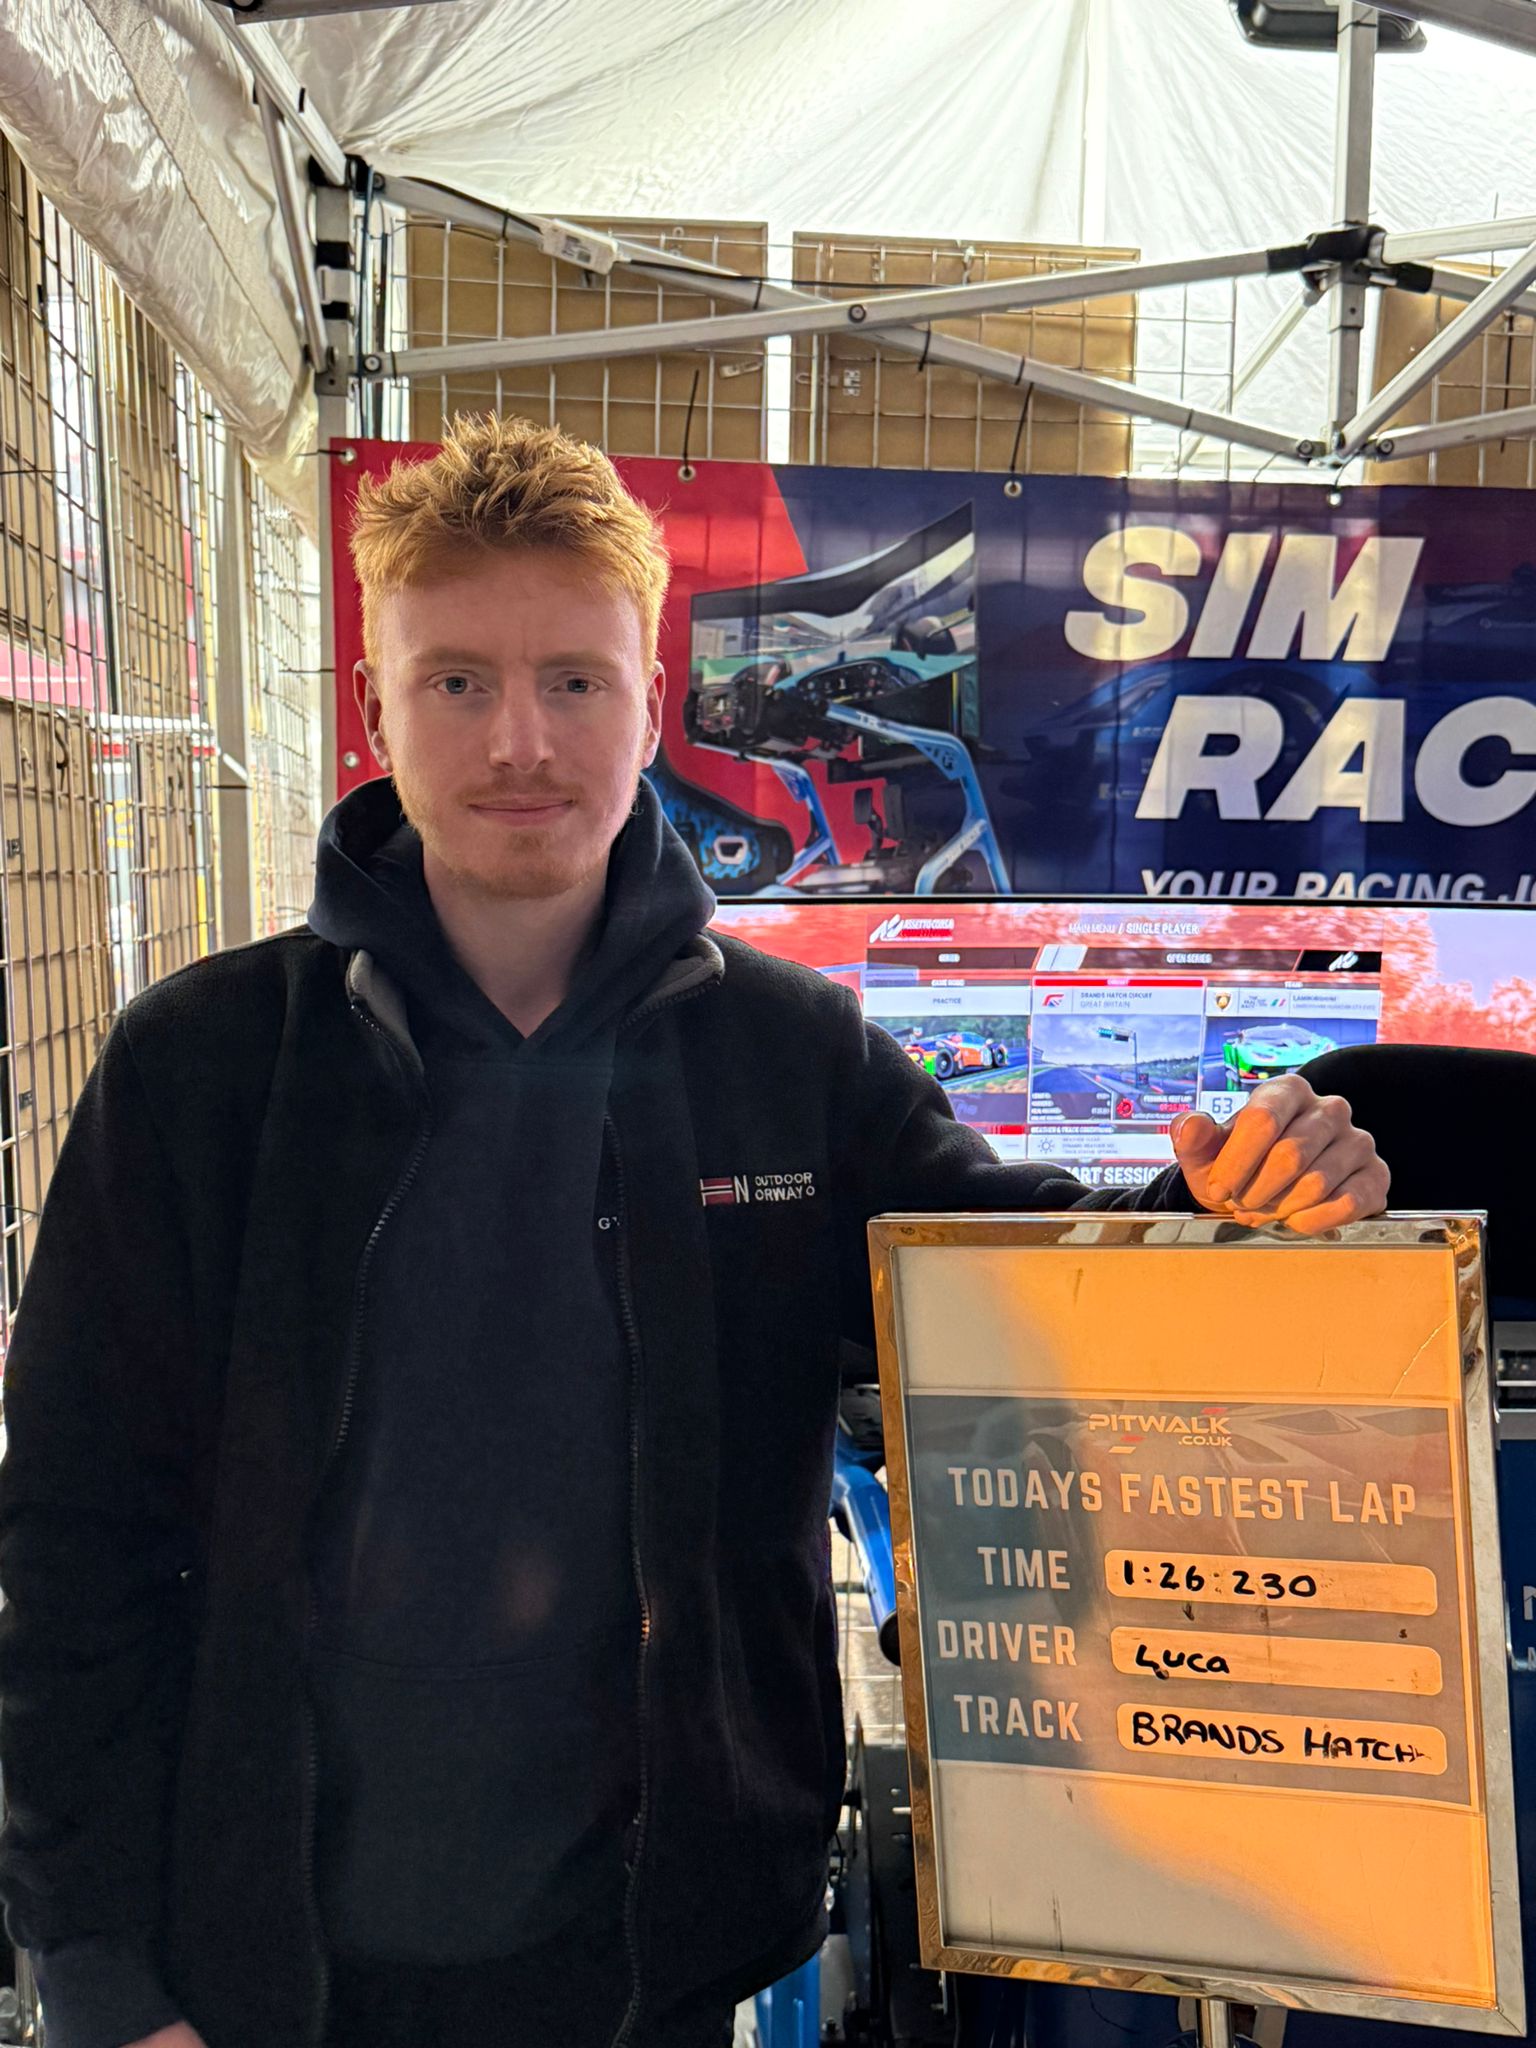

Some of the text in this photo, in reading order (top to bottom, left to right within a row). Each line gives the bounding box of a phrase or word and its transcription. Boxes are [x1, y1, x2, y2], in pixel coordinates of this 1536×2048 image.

[1064, 525, 1426, 662] SIM
[1126, 923, 1160, 934] SINGLE
[1162, 923, 1199, 935] PLAYER
[1212, 1097, 1233, 1114] 63
[755, 1172, 812, 1187] OUTDOOR
[1087, 1413, 1232, 1435] PITWALK
[1177, 1435, 1233, 1447] .CO.UK
[948, 1466, 1417, 1526] TODAYS FASTEST LAP
[976, 1546, 1072, 1591] TIME
[937, 1619, 1079, 1667] DRIVER
[952, 1693, 1083, 1743] TRACK
[1131, 1711, 1422, 1764] BRANDS HATCH
